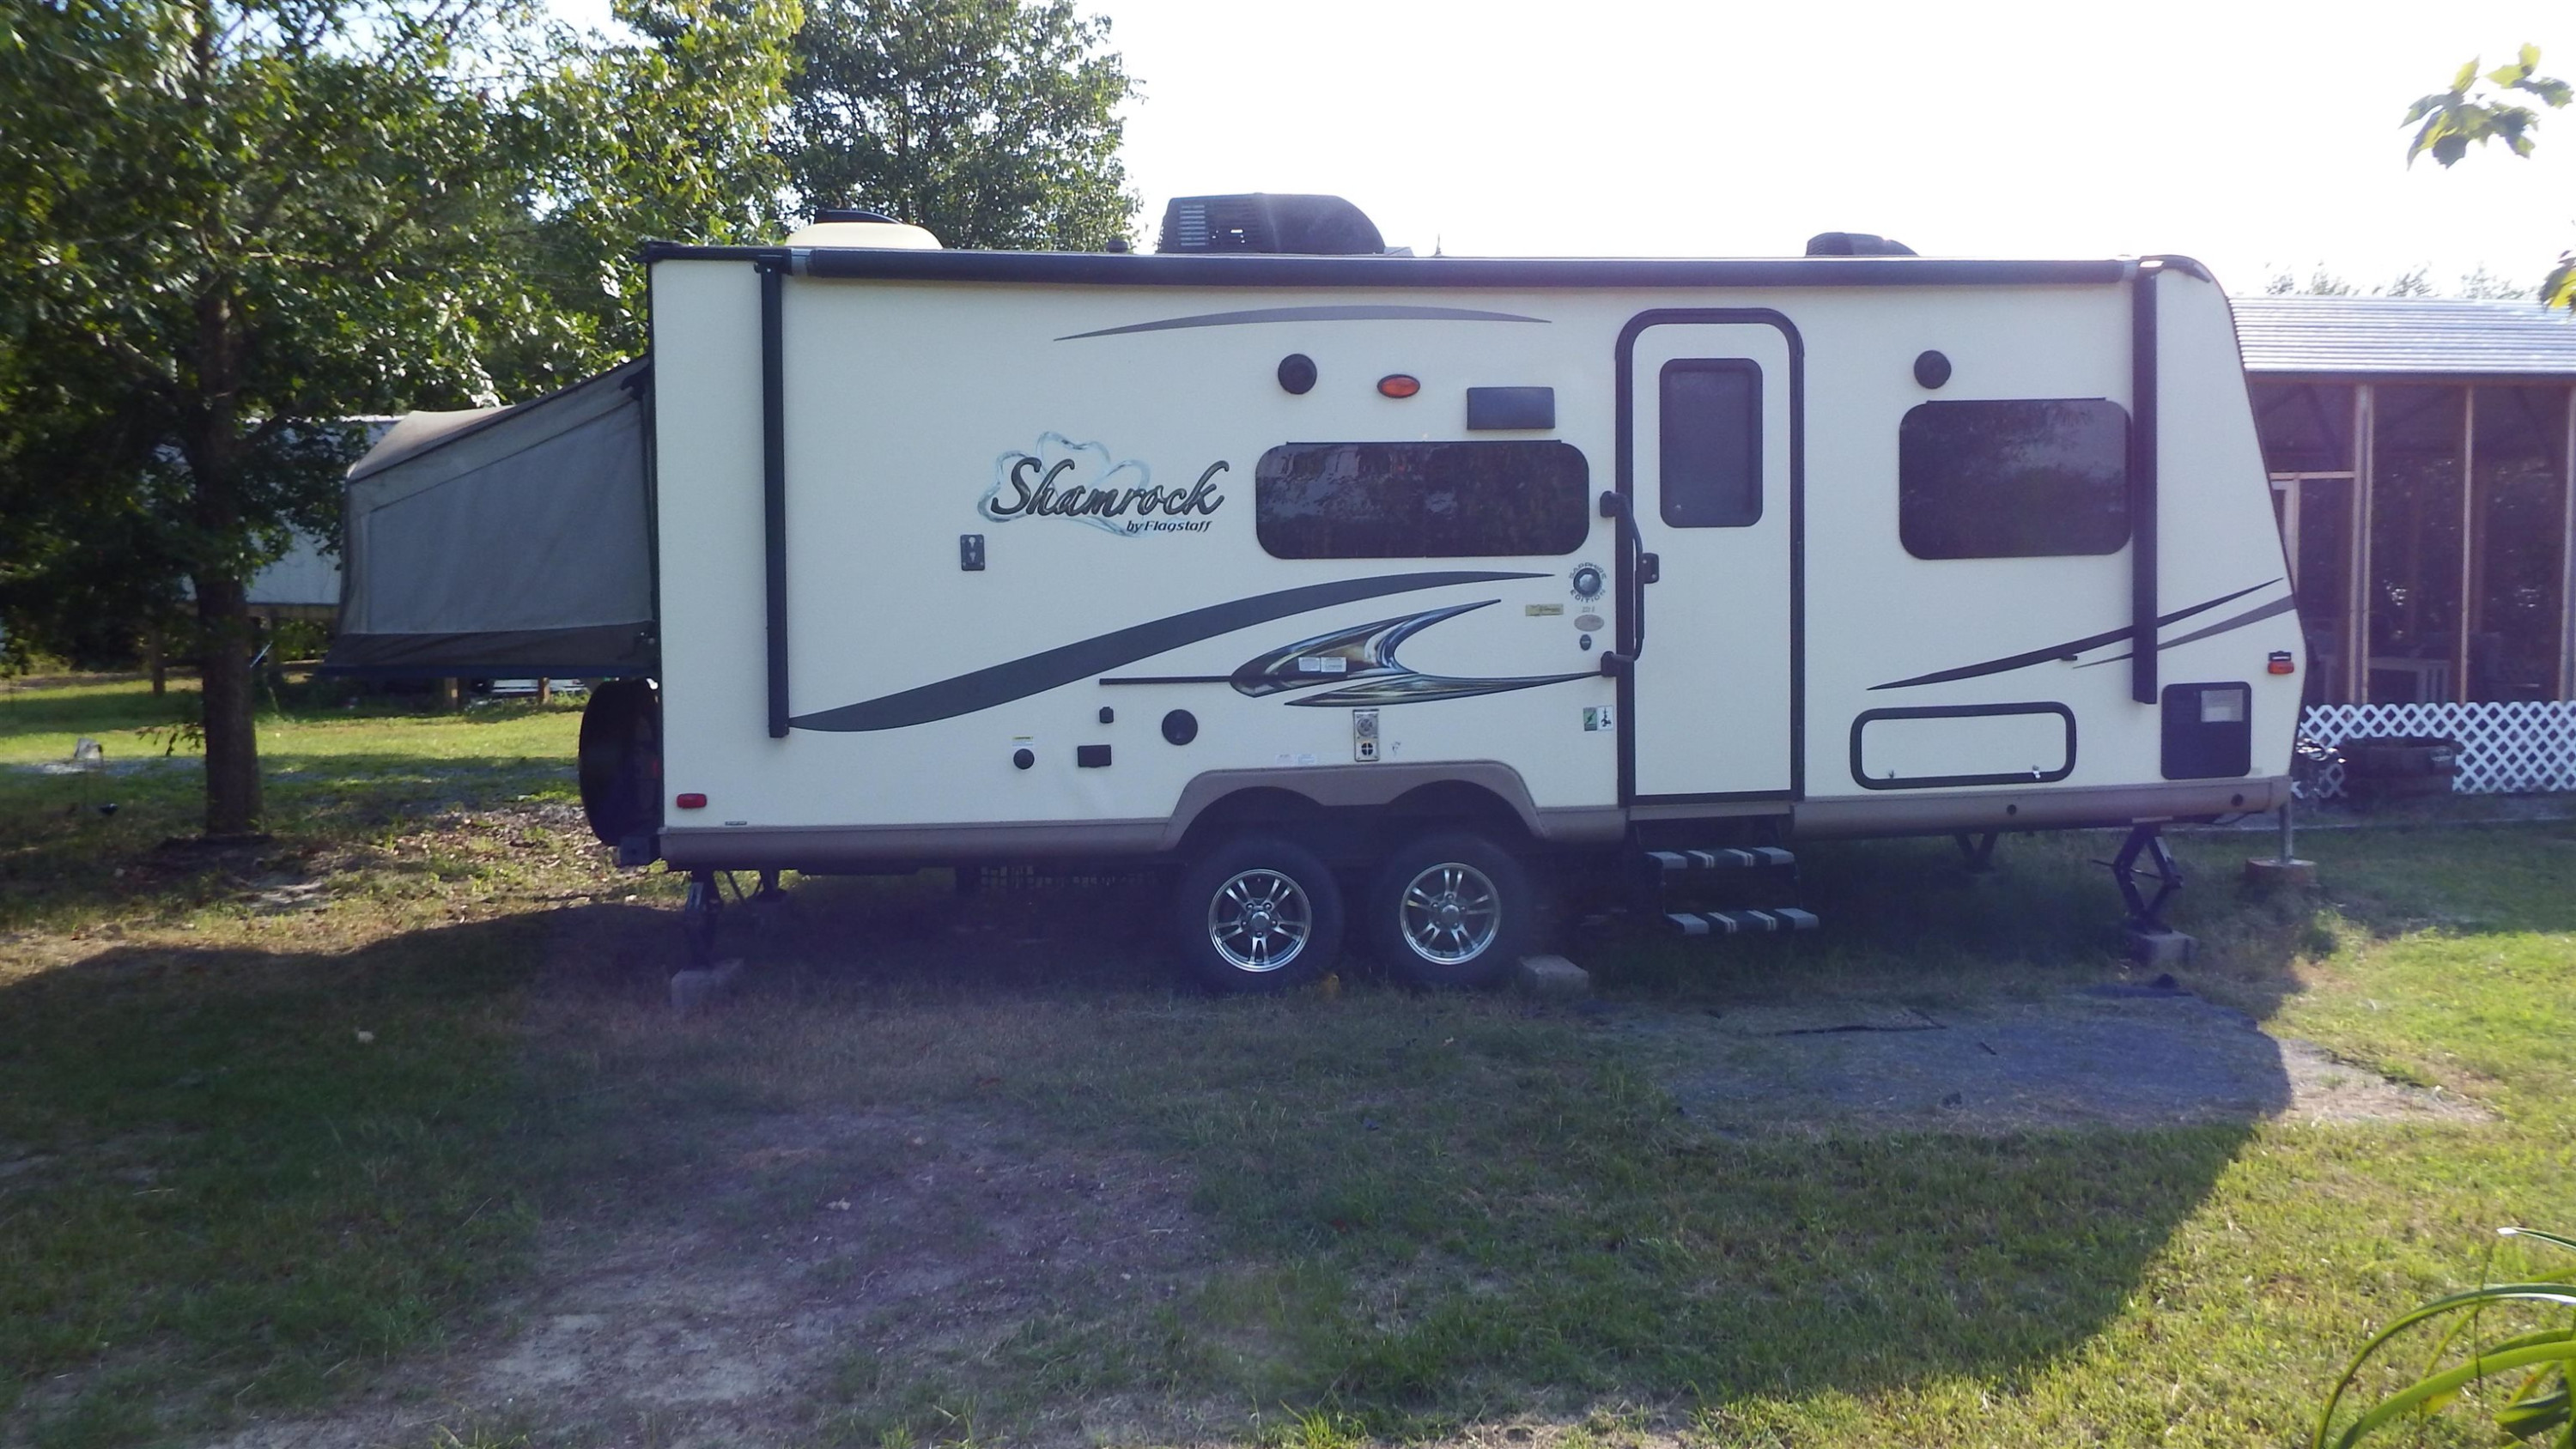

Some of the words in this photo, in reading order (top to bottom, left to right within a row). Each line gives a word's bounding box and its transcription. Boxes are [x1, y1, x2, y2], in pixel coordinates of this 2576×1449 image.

[990, 457, 1230, 517] Shamrock
[1127, 520, 1144, 533] by
[1144, 520, 1212, 533] Flagstaff
[1570, 589, 1606, 603] EDITION
